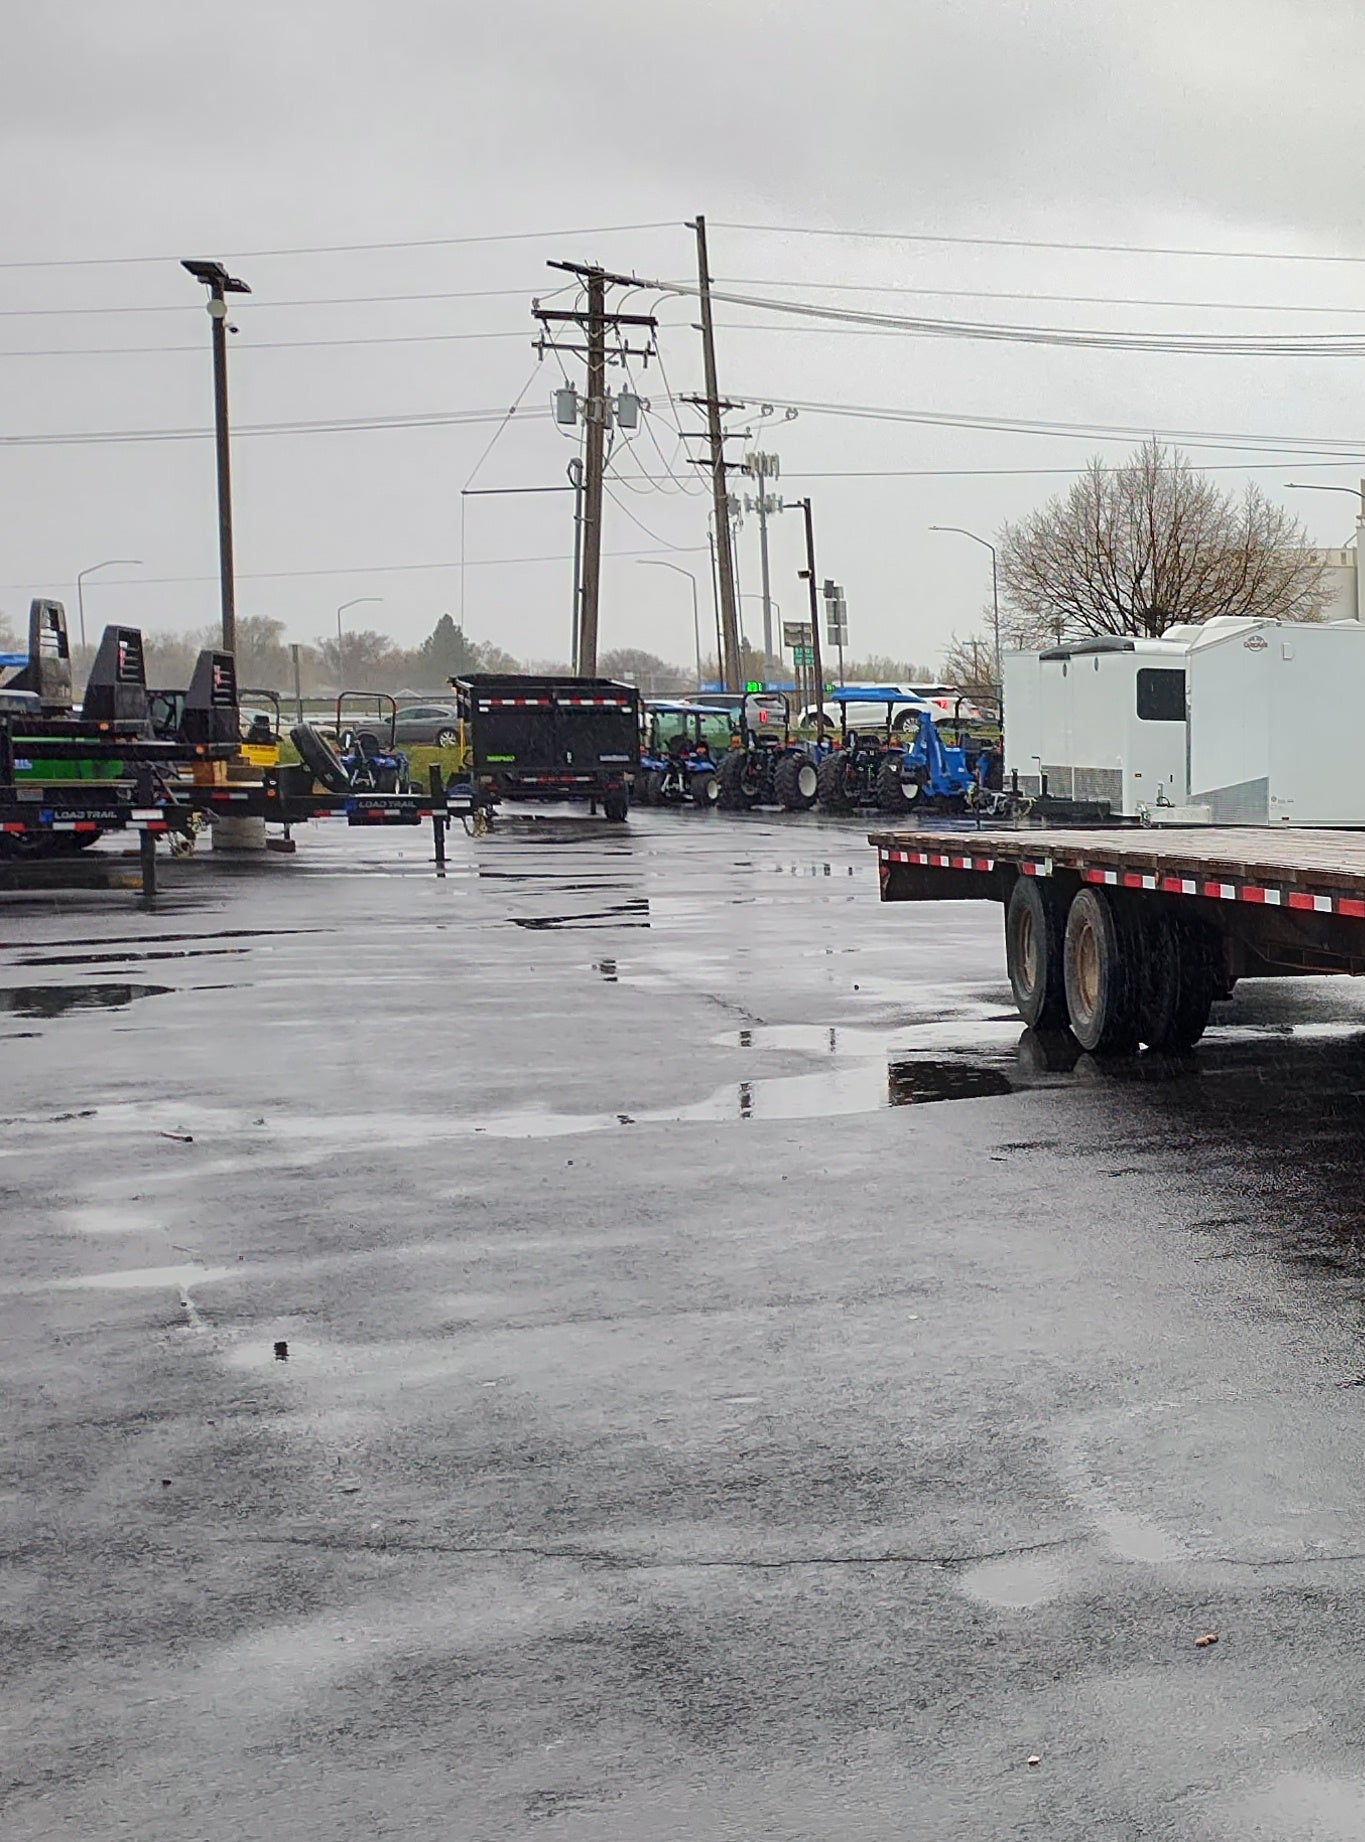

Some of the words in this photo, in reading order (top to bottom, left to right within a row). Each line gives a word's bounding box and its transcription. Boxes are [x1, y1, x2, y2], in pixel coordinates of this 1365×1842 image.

[388, 800, 417, 808] TRAIL
[54, 810, 86, 819] LOAD
[86, 810, 118, 819] TRAIL
